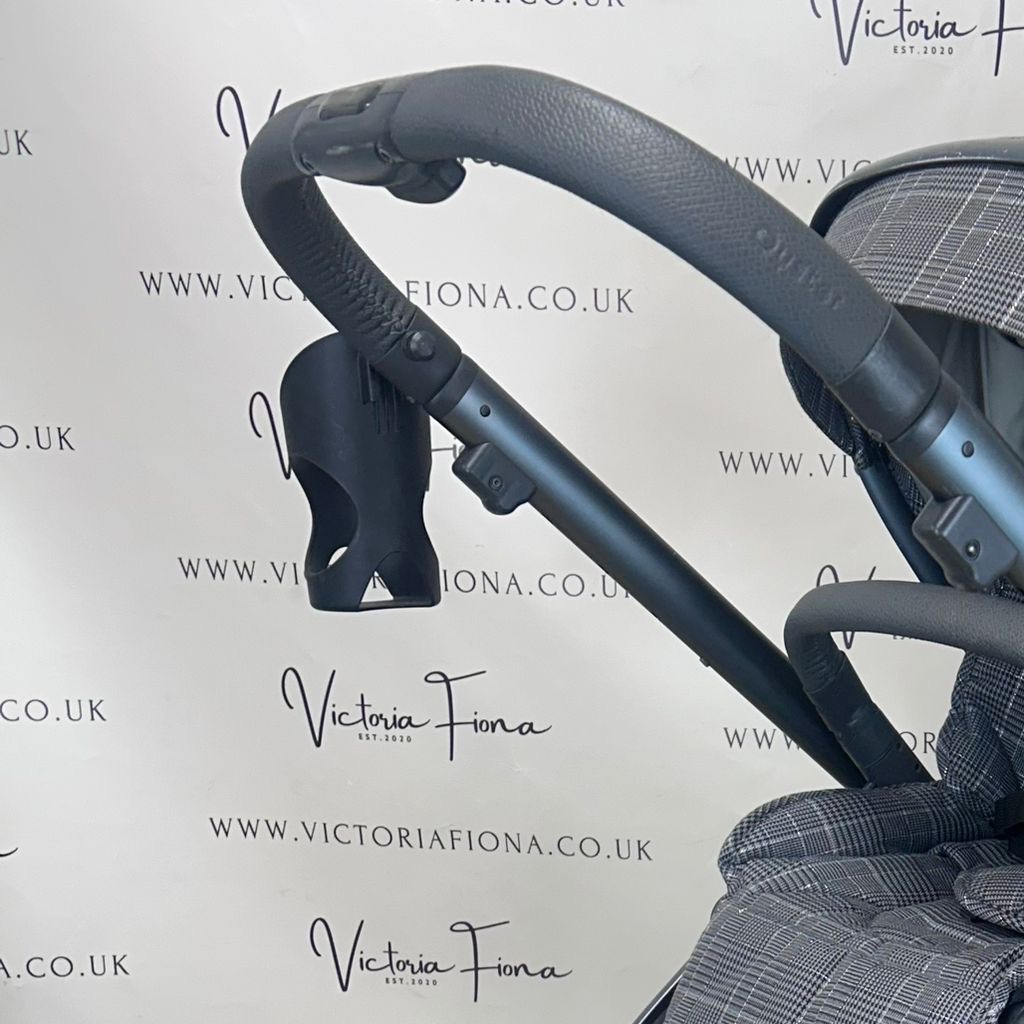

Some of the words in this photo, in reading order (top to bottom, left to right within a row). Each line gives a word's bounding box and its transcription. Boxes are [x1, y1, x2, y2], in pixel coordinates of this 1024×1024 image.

[893, 45, 954, 56] EST.2020
[281, 667, 430, 748] Victoria
[424, 671, 552, 761] Fiona
[358, 732, 412, 743] EST.2020
[209, 817, 653, 862] WWW.VICTORIAFIONA.CO.UK
[310, 917, 456, 992] Victoria
[450, 921, 572, 1003] Fiona
[385, 977, 438, 987] EST.2020
